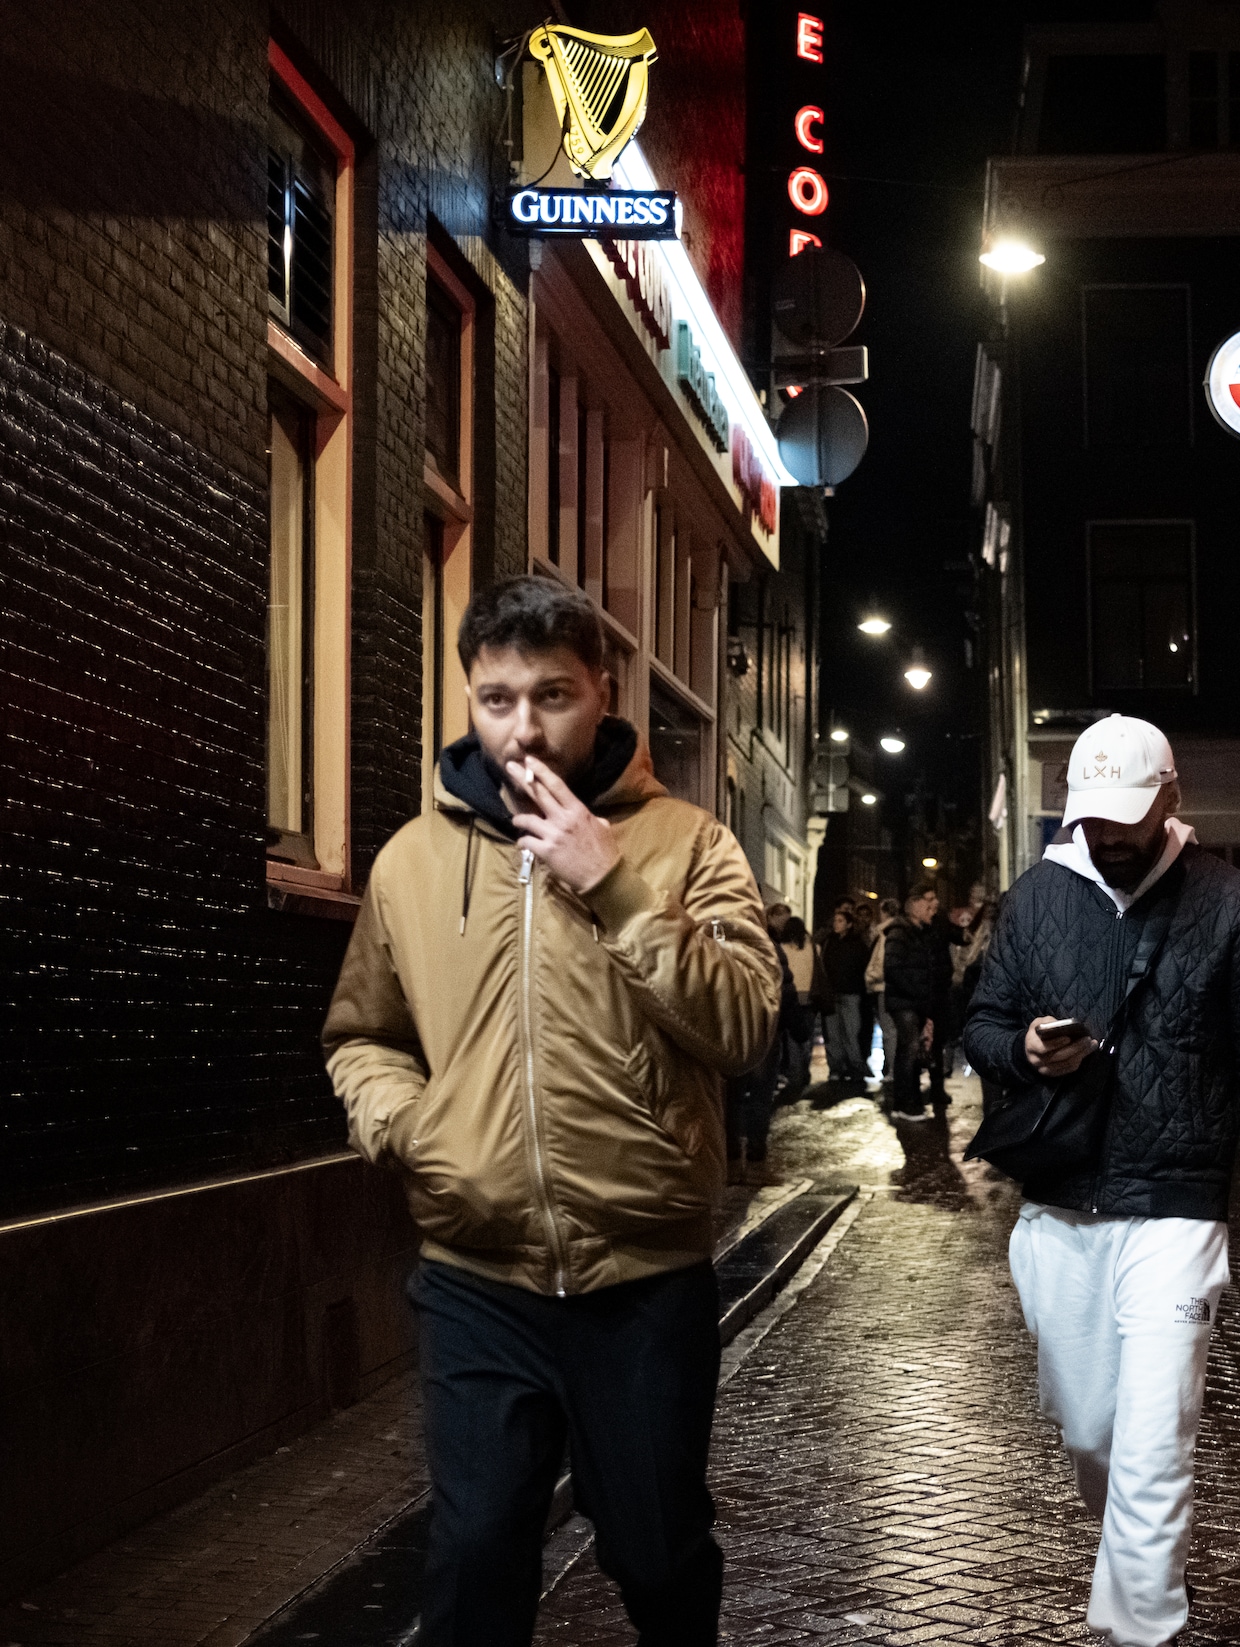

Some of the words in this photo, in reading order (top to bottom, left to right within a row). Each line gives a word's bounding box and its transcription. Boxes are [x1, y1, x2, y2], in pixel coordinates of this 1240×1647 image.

[511, 190, 670, 225] GUINNESS
[1190, 1297, 1204, 1305] THE
[1175, 1304, 1204, 1312] NORTH
[1185, 1312, 1202, 1320] FACE
